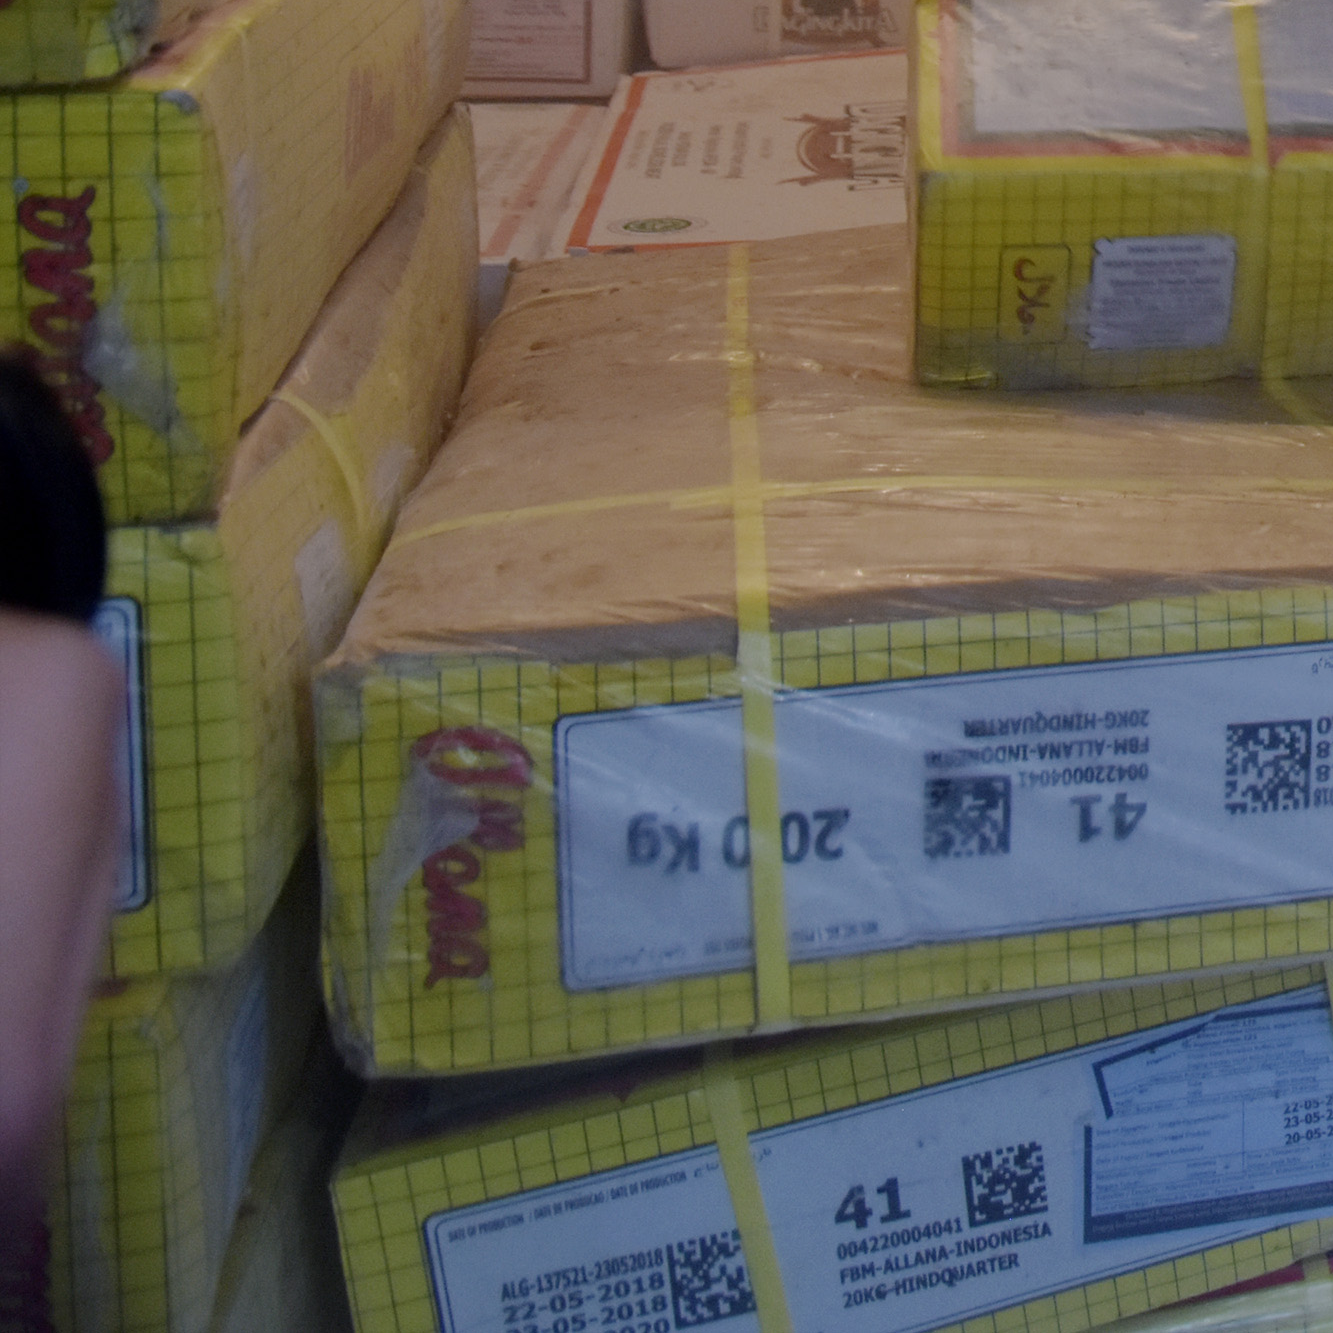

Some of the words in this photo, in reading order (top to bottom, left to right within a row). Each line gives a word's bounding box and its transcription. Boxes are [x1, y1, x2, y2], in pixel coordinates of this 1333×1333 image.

[626, 812, 702, 875] Kg
[721, 808, 851, 869] 200
[1069, 792, 1147, 843] 41
[641, 1170, 687, 1193] PRODUCTION
[834, 1176, 911, 1230] 41
[837, 1217, 964, 1261] 004220004041
[839, 1221, 1053, 1286] FBM-ALLANA-INDONESIA
[501, 1247, 664, 1303] ALG-137521-23052018
[503, 1271, 666, 1326] 22-05-2018
[843, 1252, 1021, 1309] 20KG-HINDQUARTER
